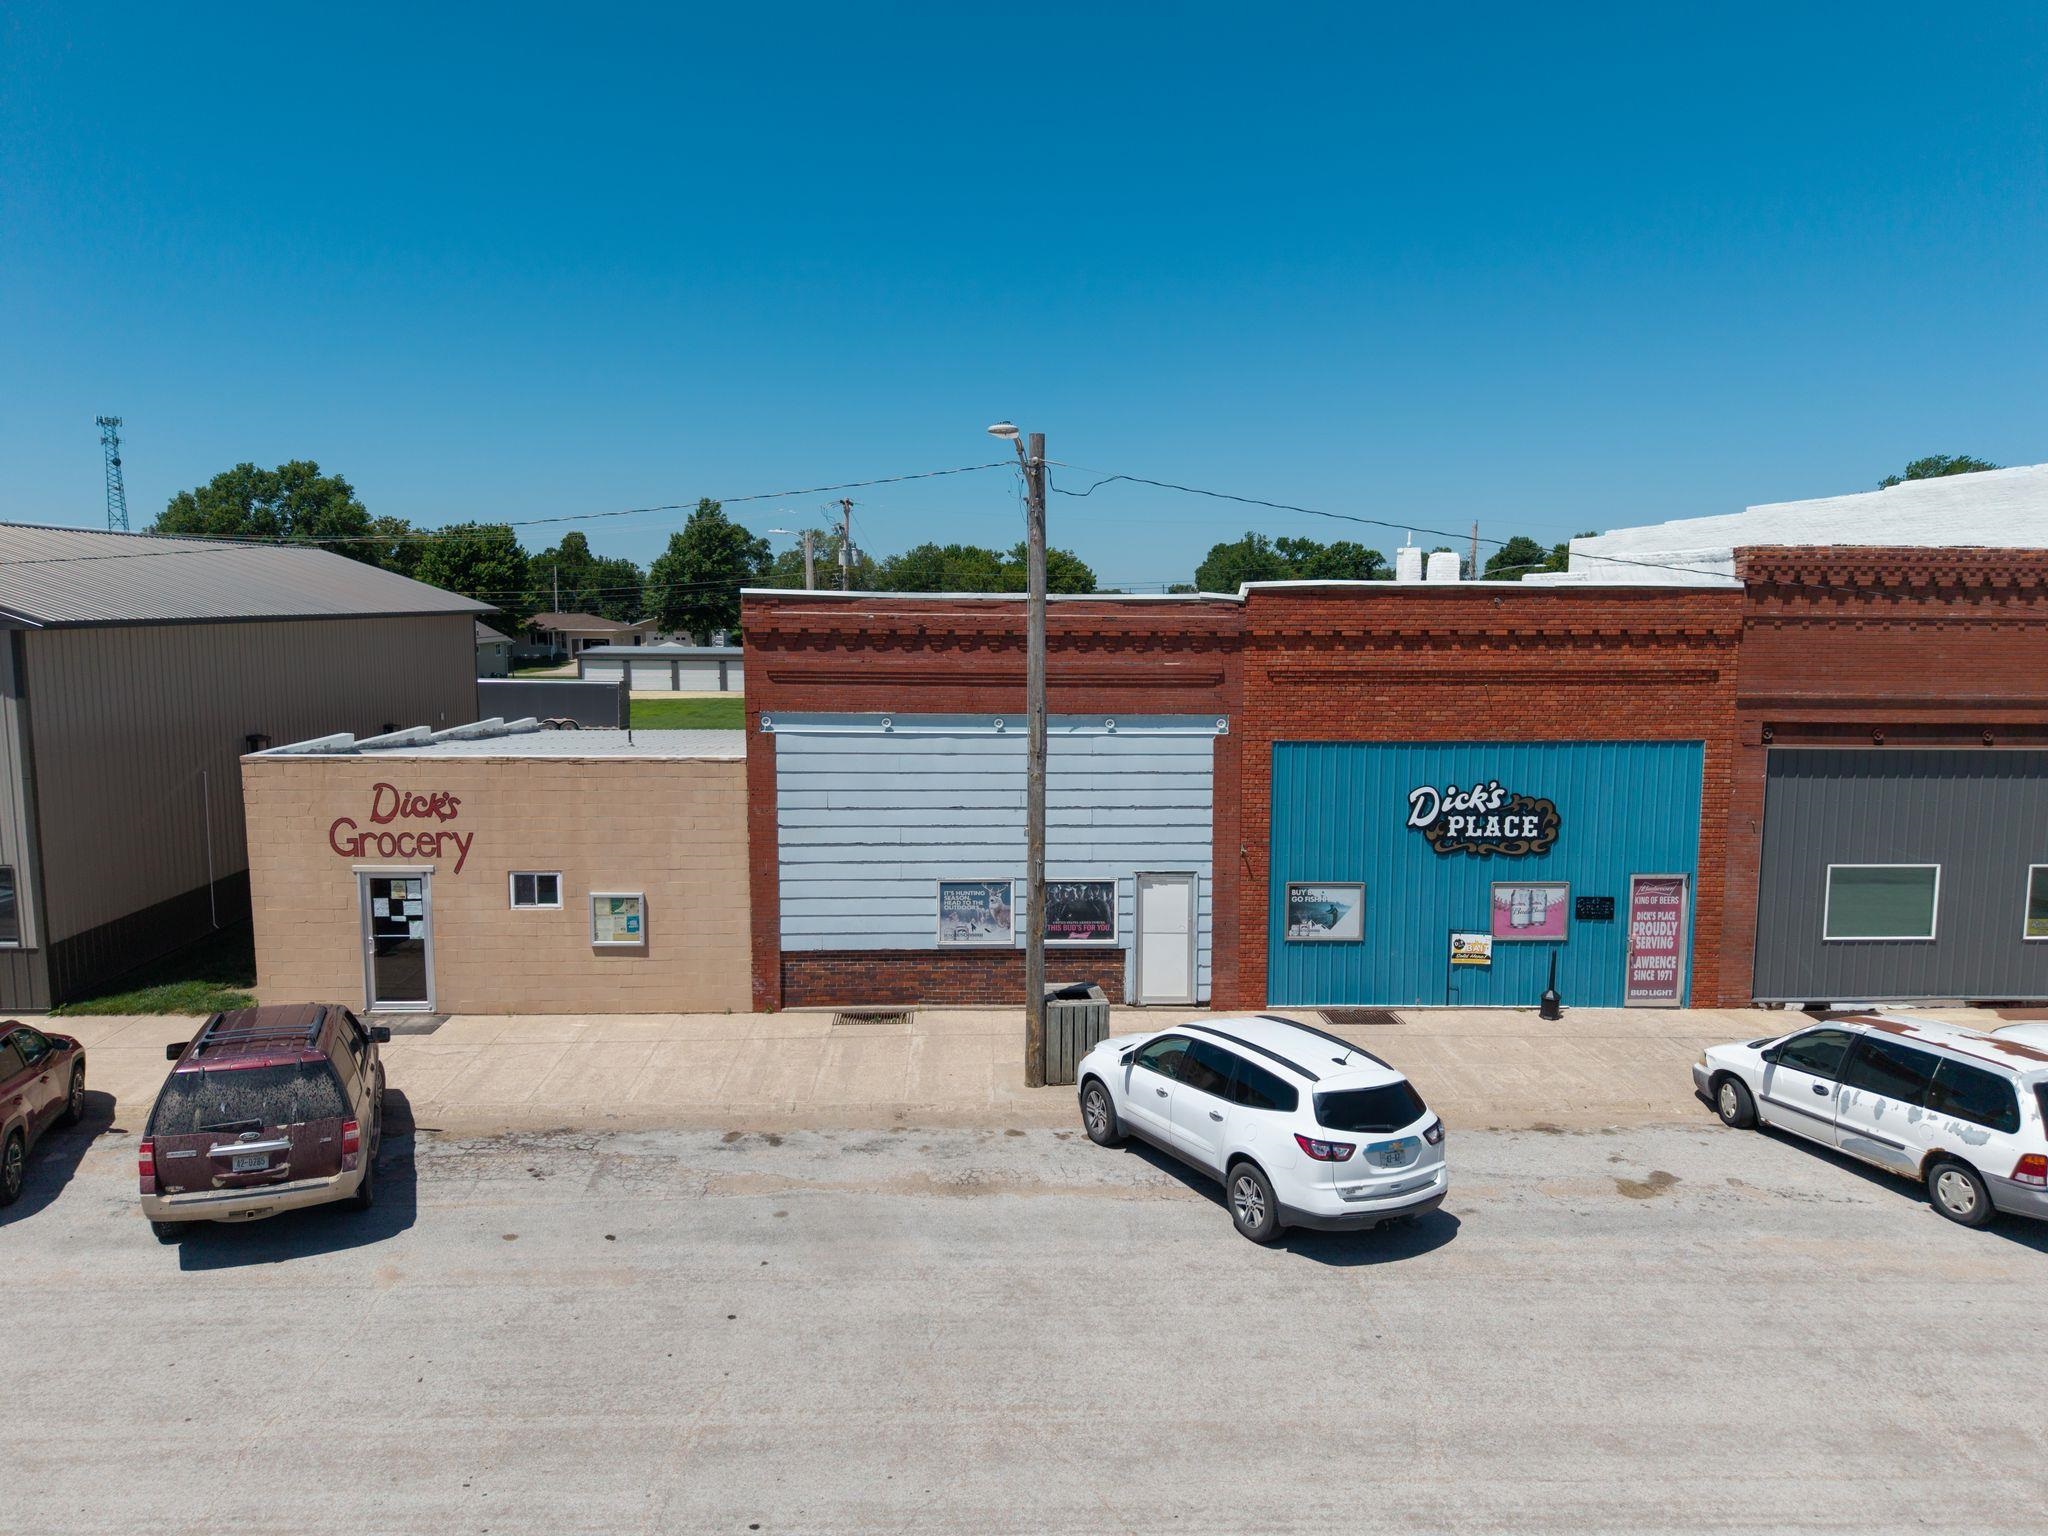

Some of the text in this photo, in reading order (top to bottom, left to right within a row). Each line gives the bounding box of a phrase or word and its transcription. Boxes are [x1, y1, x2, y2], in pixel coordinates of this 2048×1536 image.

[370, 782, 461, 824] Dick's
[1408, 781, 1506, 827] Dick's
[1447, 815, 1539, 837] PLACE
[329, 817, 474, 875] Grocery
[1634, 896, 1680, 905] KING OF BEERS
[1636, 911, 1676, 921] DICK'S PLACE
[1047, 924, 1062, 932] THIS
[1062, 924, 1083, 932] BUD'S
[1083, 924, 1096, 932] FOR
[1632, 921, 1678, 936] PROUDLY
[1635, 936, 1674, 949] SERVING
[1633, 969, 1673, 981] SINCE 1971
